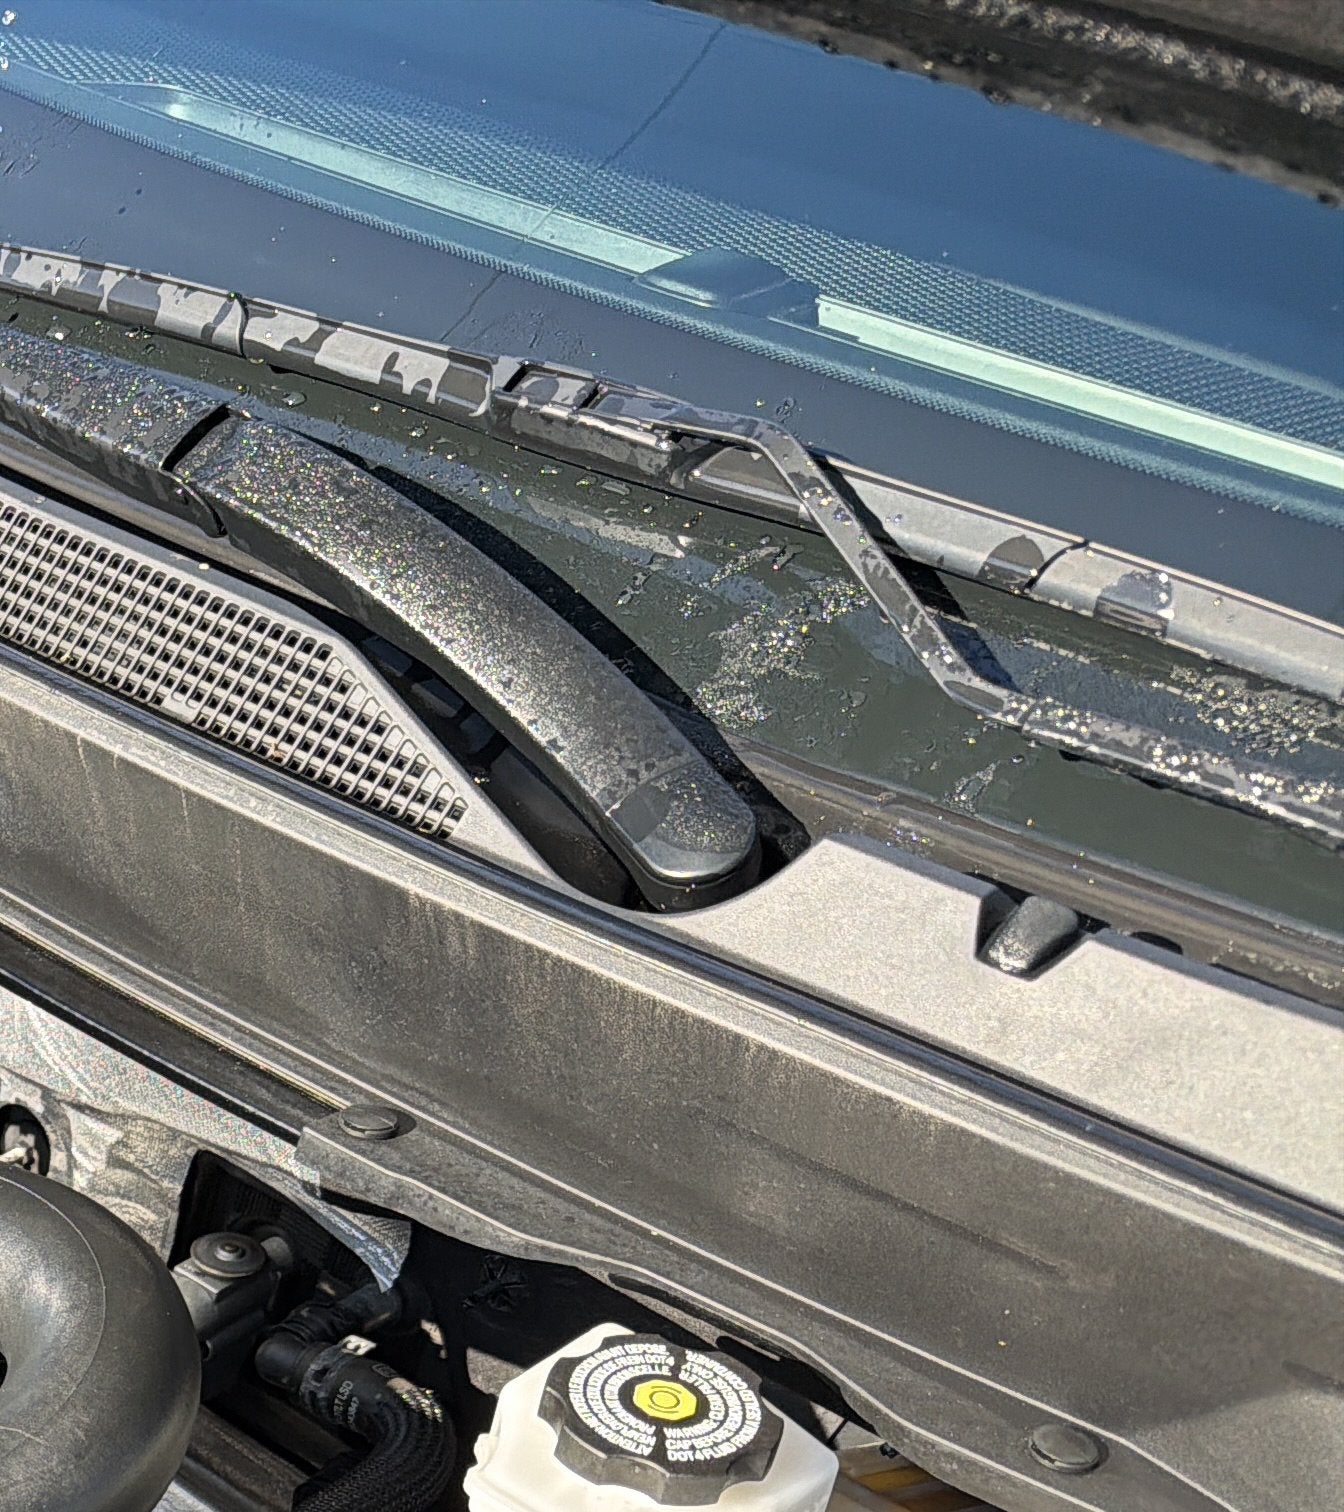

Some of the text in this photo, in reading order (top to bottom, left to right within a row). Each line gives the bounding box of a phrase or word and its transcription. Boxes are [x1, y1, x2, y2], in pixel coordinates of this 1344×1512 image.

[643, 1354, 665, 1365] DOT
[665, 1356, 675, 1366] 4
[680, 1360, 715, 1380] ONLY
[735, 1389, 761, 1421] SEALED
[665, 1438, 694, 1449] CAP
[690, 1426, 734, 1448] BEFORE
[727, 1423, 758, 1448] FROM
[667, 1449, 696, 1460] DOT
[691, 1449, 706, 1460] 4
[700, 1440, 740, 1459] FLUID
